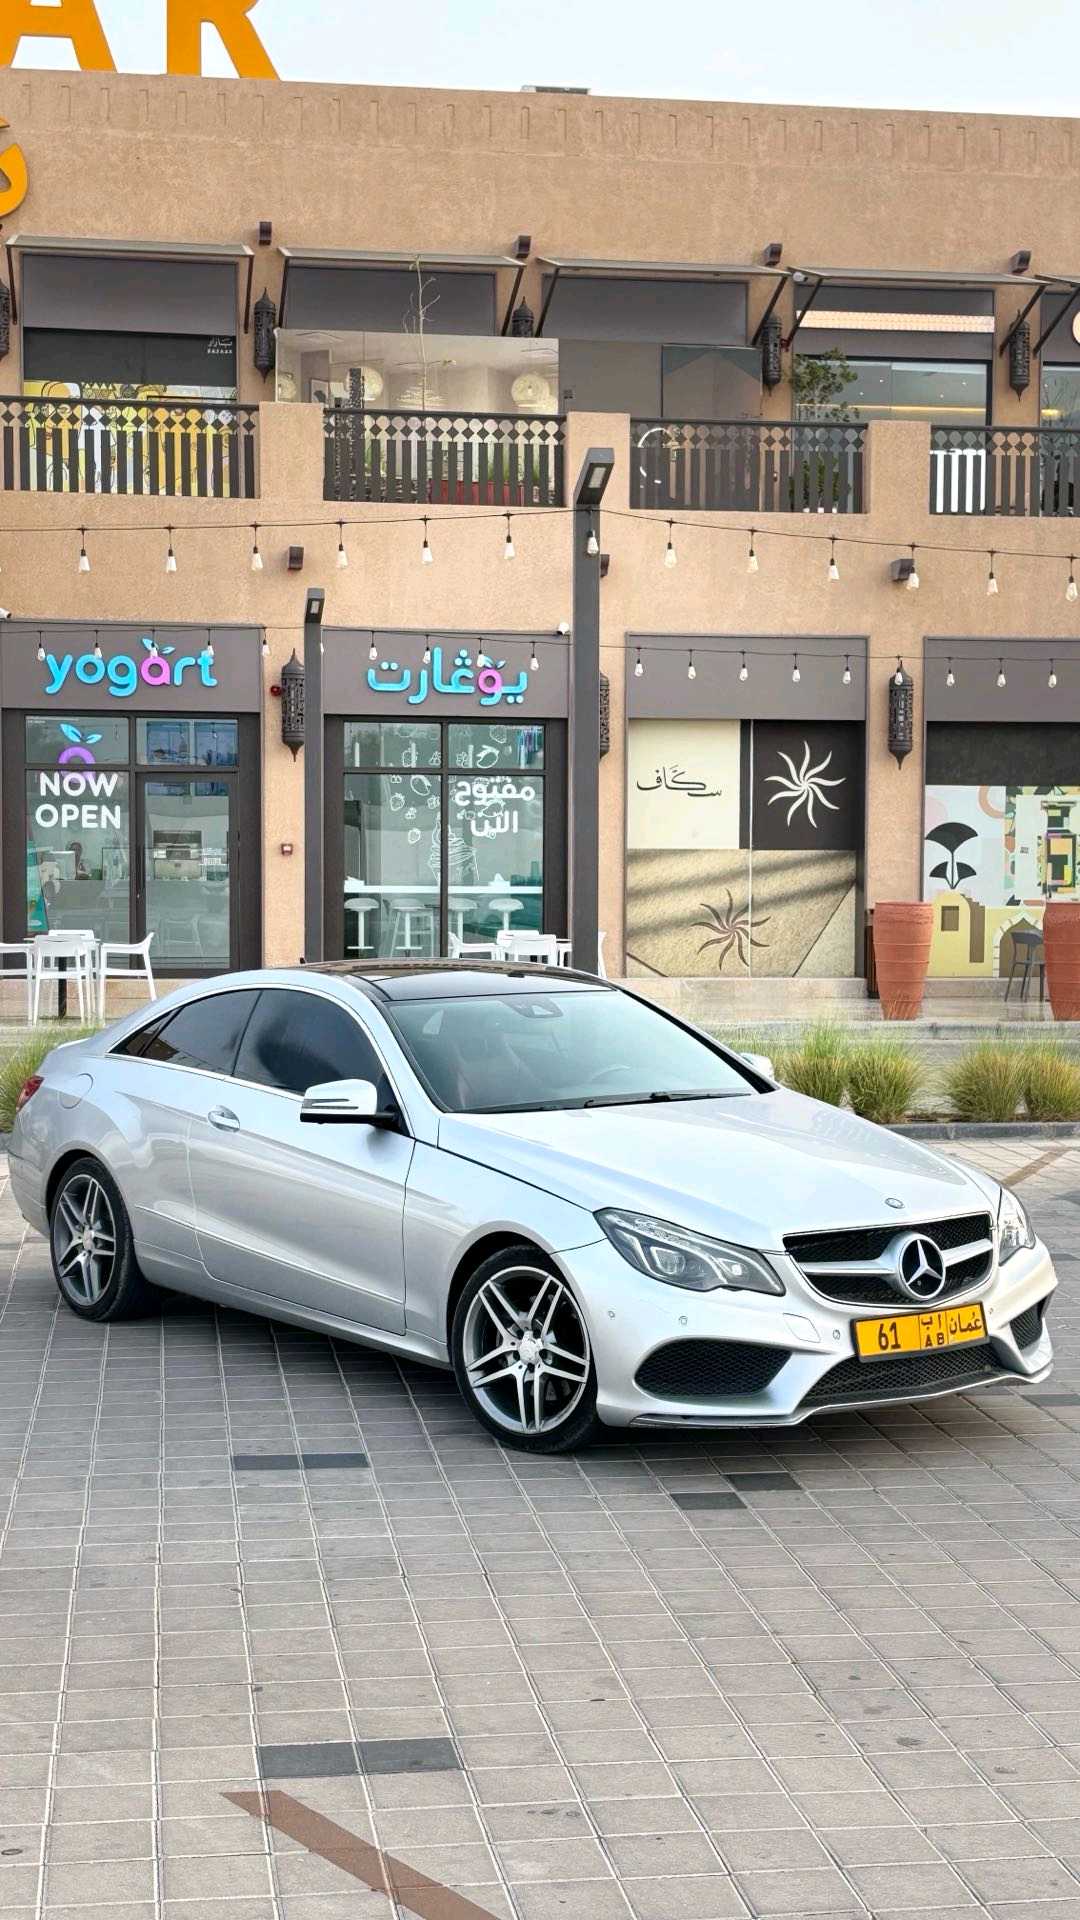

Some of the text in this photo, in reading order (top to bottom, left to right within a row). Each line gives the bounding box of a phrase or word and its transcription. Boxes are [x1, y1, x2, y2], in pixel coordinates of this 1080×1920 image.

[45, 649, 218, 698] yogart
[40, 771, 119, 797] NOW
[35, 803, 121, 829] OPEN
[878, 1321, 901, 1351] 61
